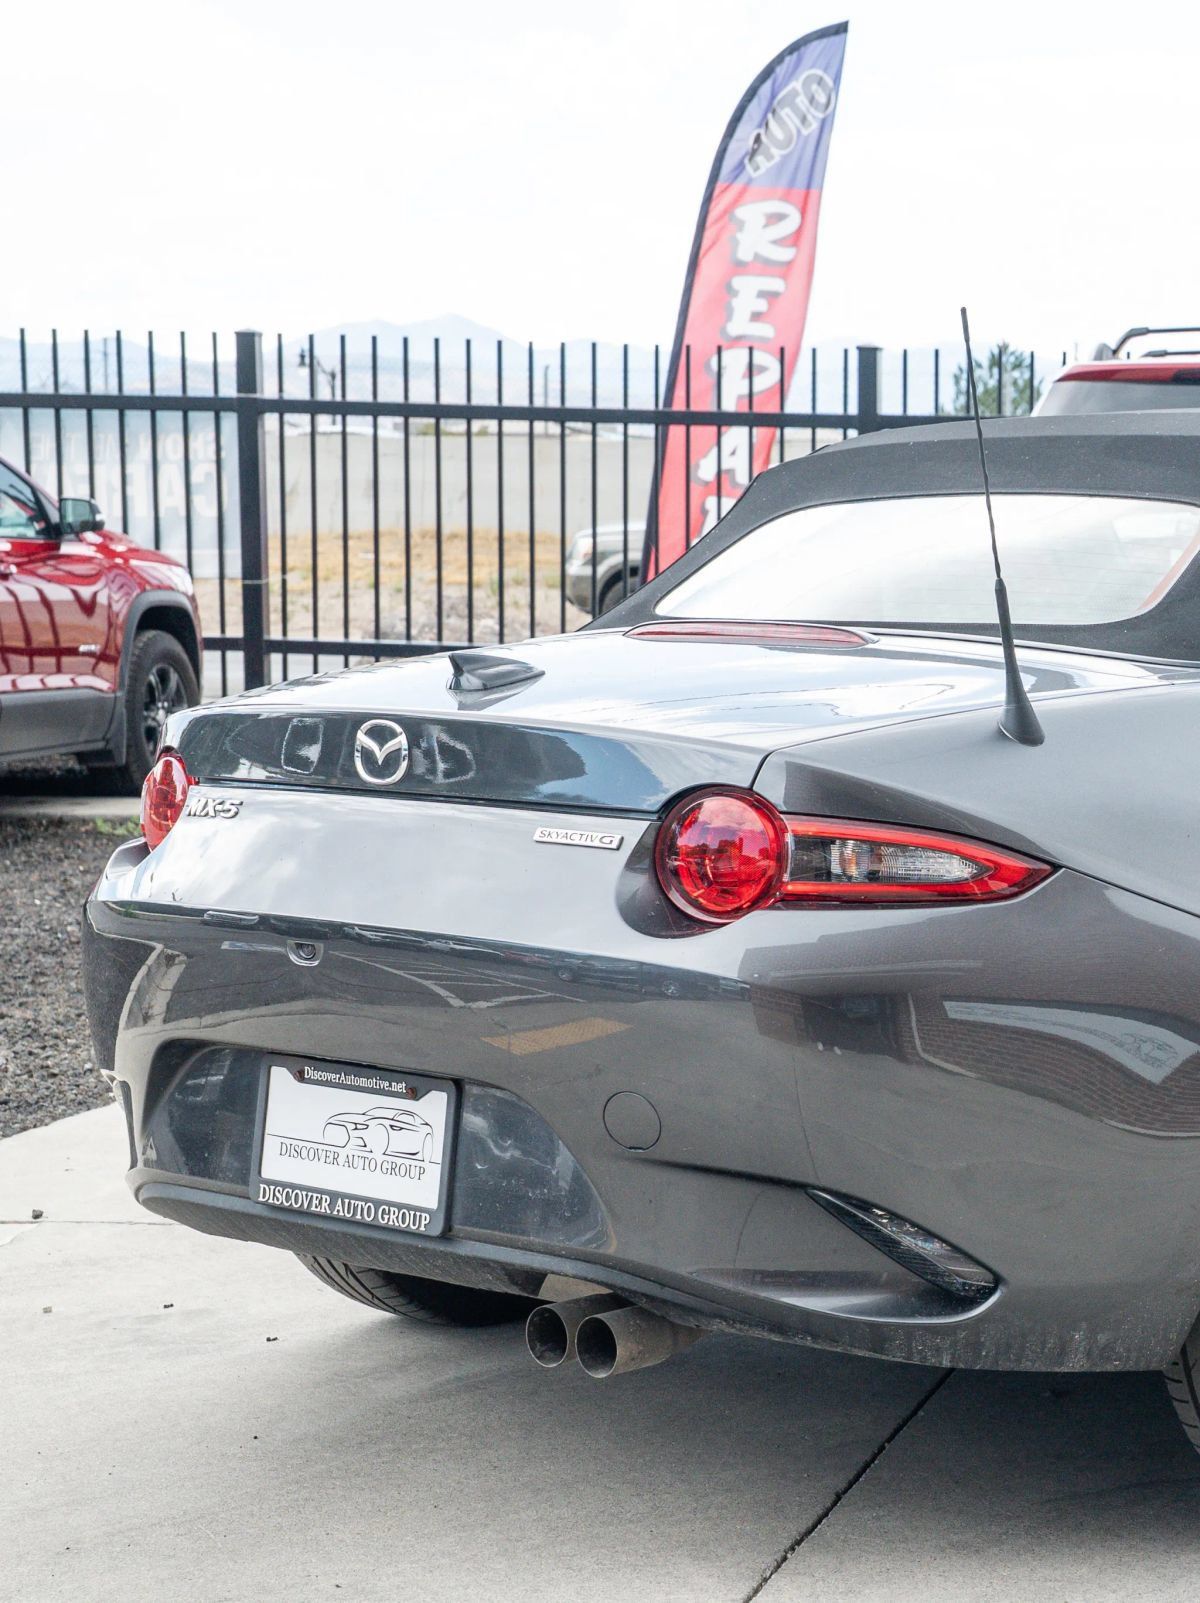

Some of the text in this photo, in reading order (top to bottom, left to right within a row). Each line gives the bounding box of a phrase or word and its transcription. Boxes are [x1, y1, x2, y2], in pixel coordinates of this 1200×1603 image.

[744, 68, 837, 177] AUTO
[187, 798, 243, 819] MX-5
[304, 1066, 407, 1094] DiscoverAutomotive.net
[279, 1141, 426, 1181] DISCOVER AUTO GROUP
[258, 1183, 431, 1231] DISCOVER AUTO GROUP
